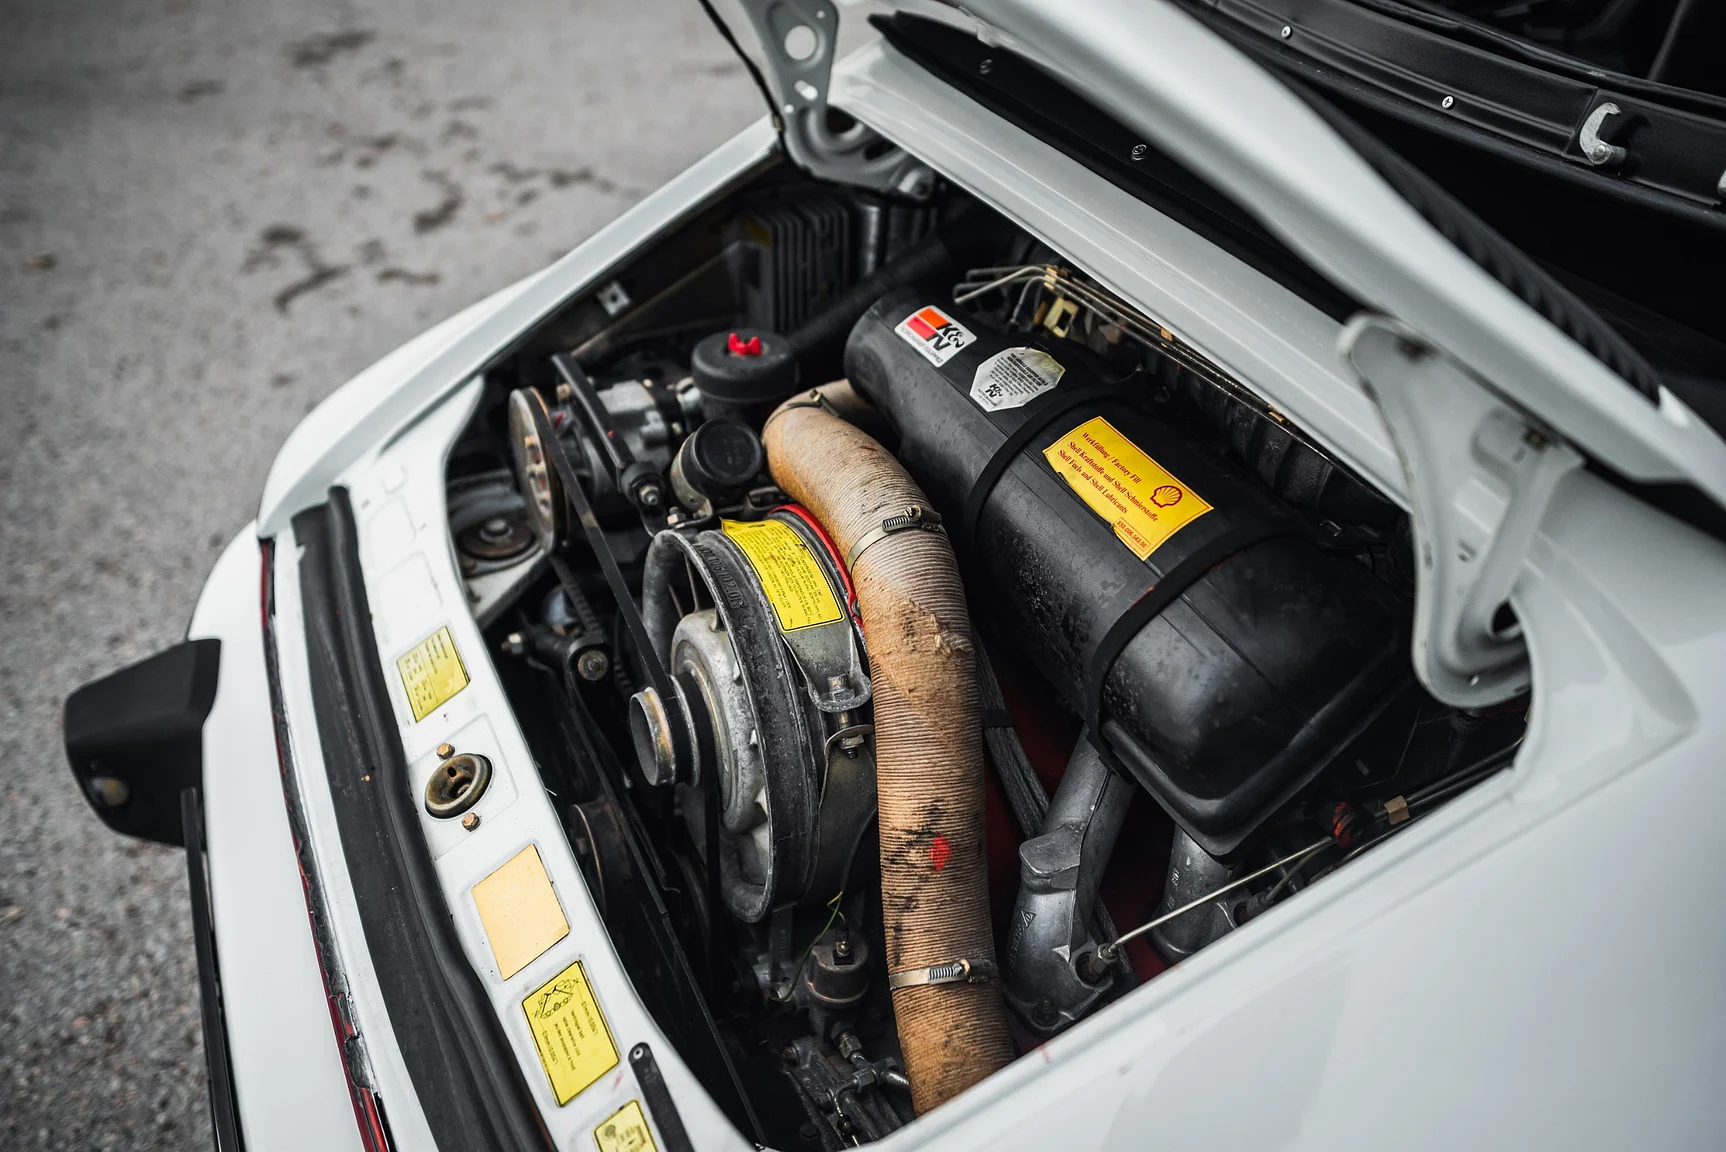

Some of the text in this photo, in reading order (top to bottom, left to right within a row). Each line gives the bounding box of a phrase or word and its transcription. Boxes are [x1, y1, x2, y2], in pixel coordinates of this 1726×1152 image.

[1058, 449, 1128, 514] Shell Fuels and Shell Lubricants
[1068, 441, 1082, 455] Shell
[1079, 450, 1106, 475] Kraftstoffe
[1113, 480, 1128, 494] Shell
[1125, 491, 1158, 522] Schmierstoffe
[1112, 458, 1131, 476] Factory
[1130, 473, 1142, 484] Fill
